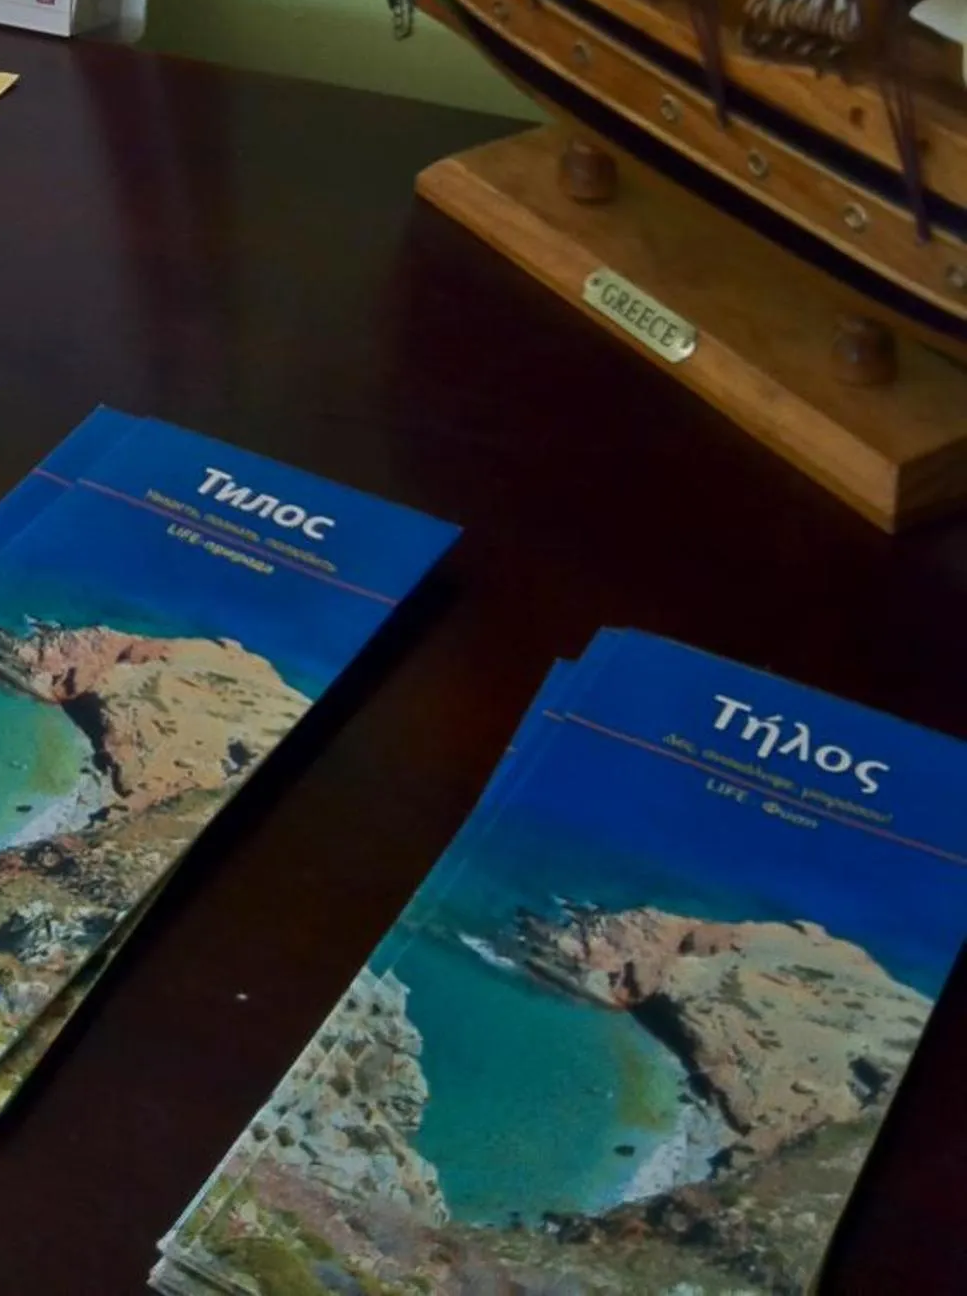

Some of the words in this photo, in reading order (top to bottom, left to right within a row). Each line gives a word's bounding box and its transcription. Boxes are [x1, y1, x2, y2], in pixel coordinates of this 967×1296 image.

[601, 283, 679, 347] GREECE
[197, 467, 336, 541] Тилос
[714, 694, 890, 794] Τήλος
